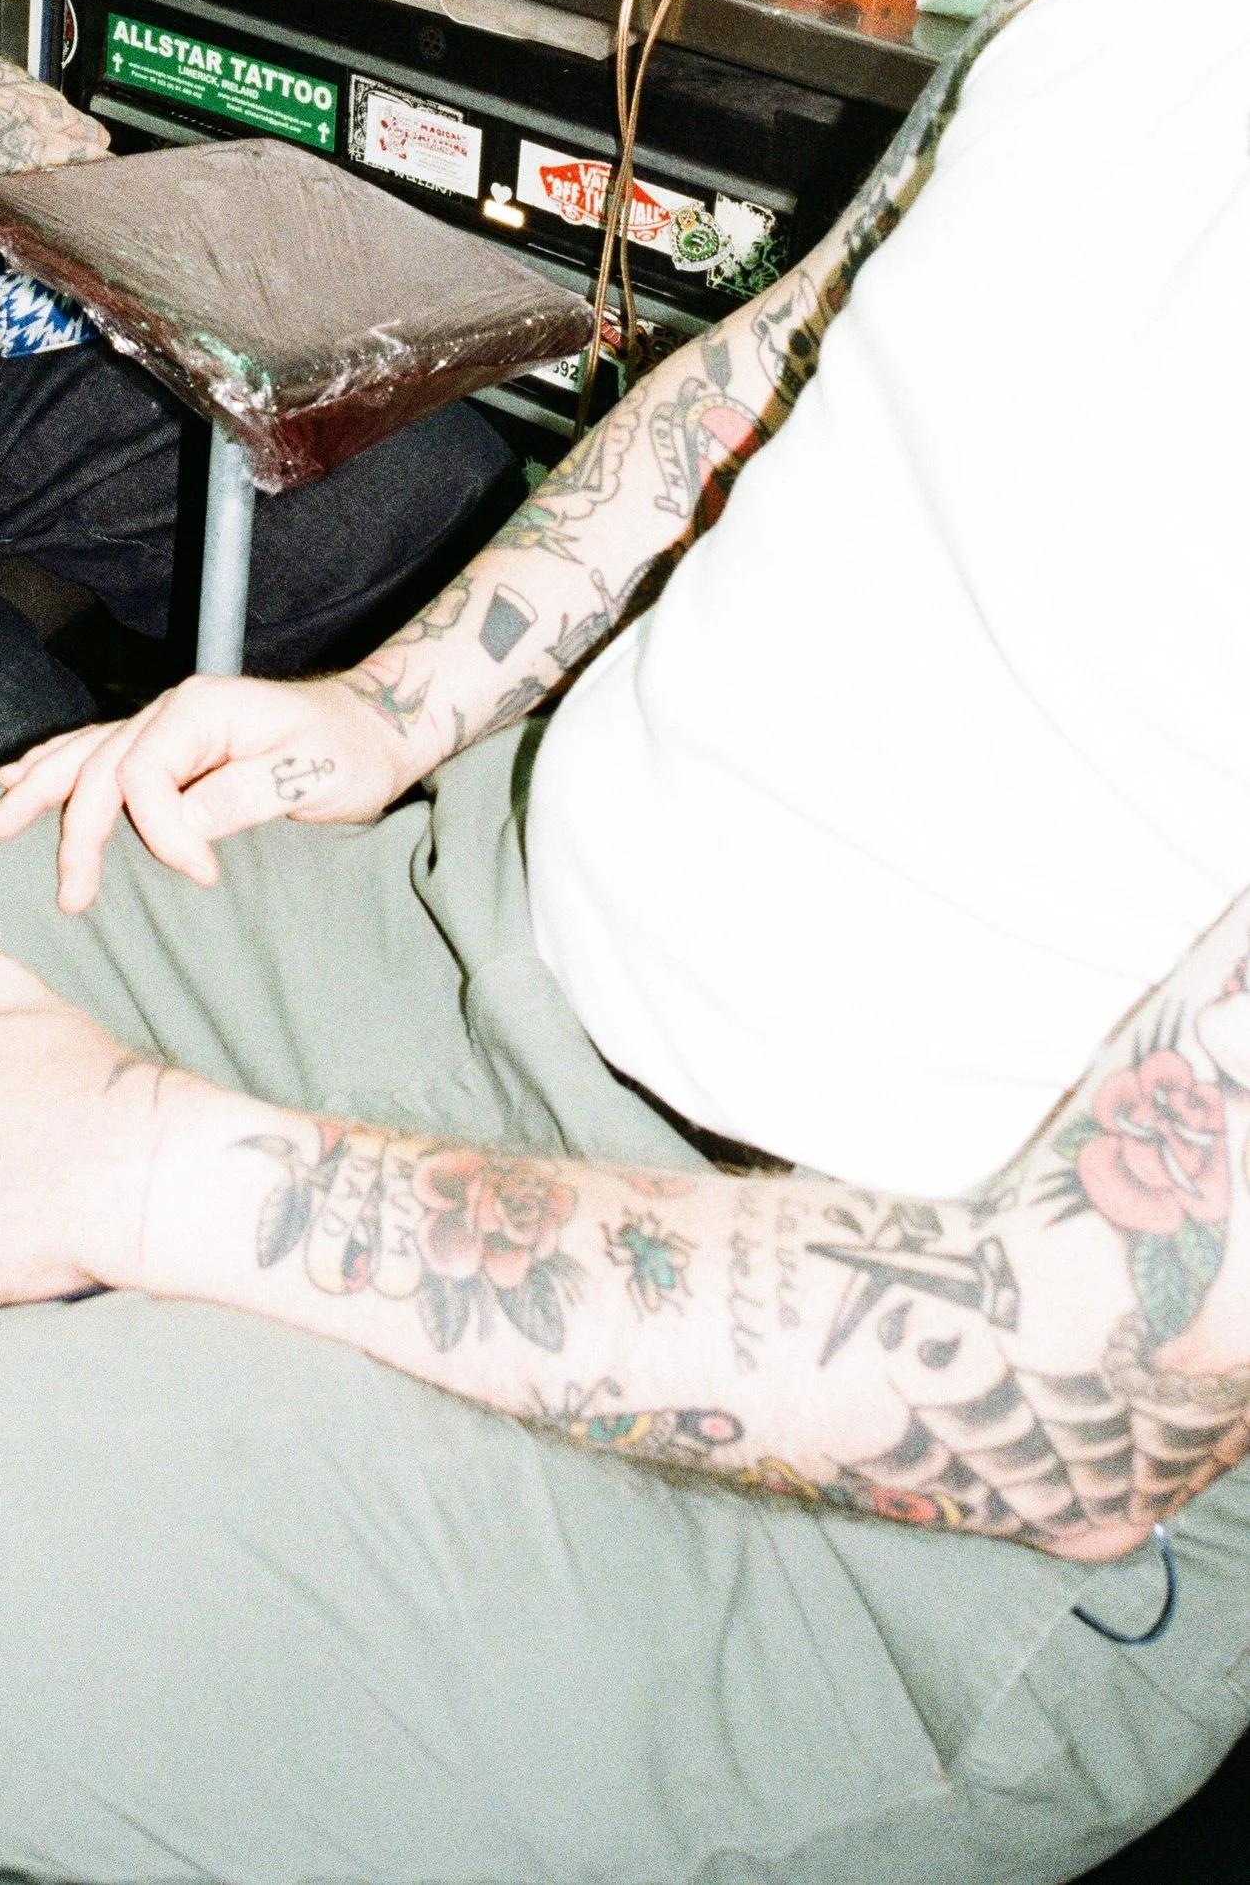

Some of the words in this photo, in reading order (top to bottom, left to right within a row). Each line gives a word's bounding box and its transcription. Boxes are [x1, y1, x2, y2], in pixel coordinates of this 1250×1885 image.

[113, 20, 223, 75] ALLSTAR
[230, 57, 333, 111] TATTOO
[178, 65, 220, 88] LIMERICK,
[221, 79, 259, 100] IRELAND
[323, 1156, 372, 1237] DAD
[387, 1155, 414, 1257] MUM
